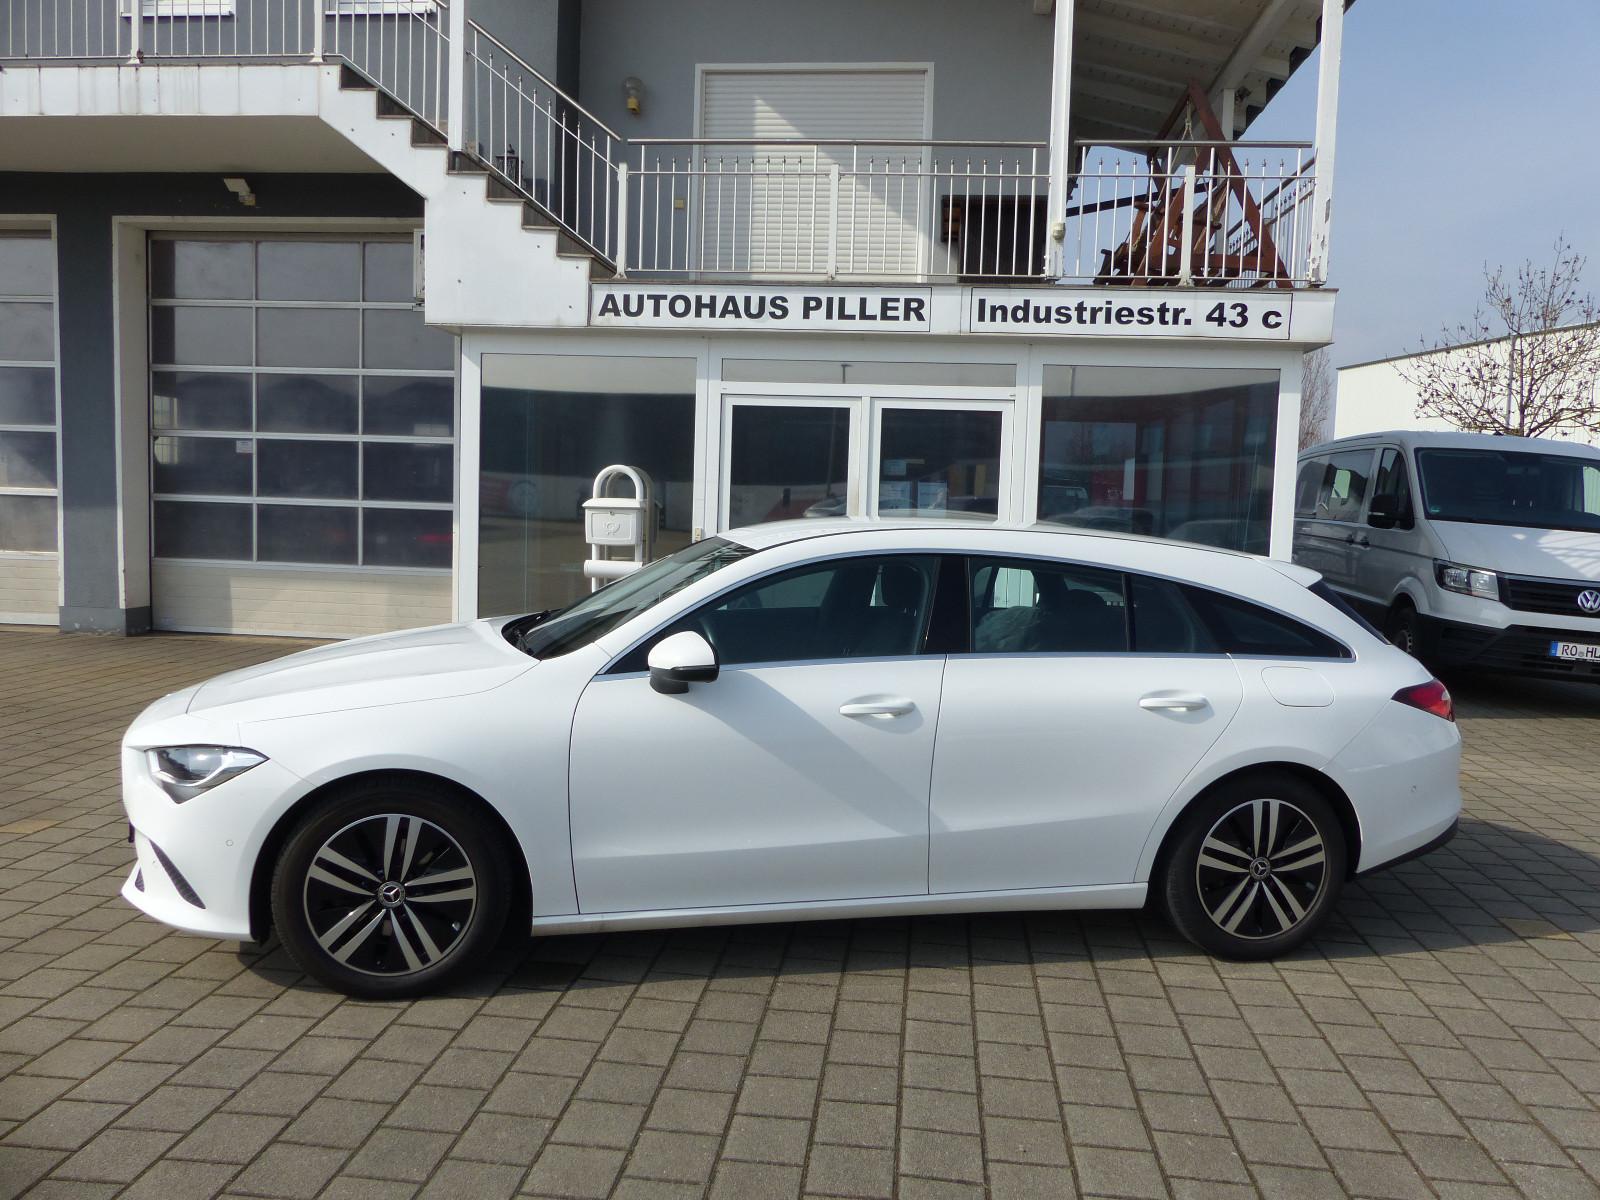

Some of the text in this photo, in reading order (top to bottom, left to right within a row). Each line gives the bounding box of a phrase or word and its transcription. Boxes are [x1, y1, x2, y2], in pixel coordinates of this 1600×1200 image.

[598, 293, 926, 321] AUTOHAUS PILLER
[977, 298, 1282, 329] Industriestr. 43 c
